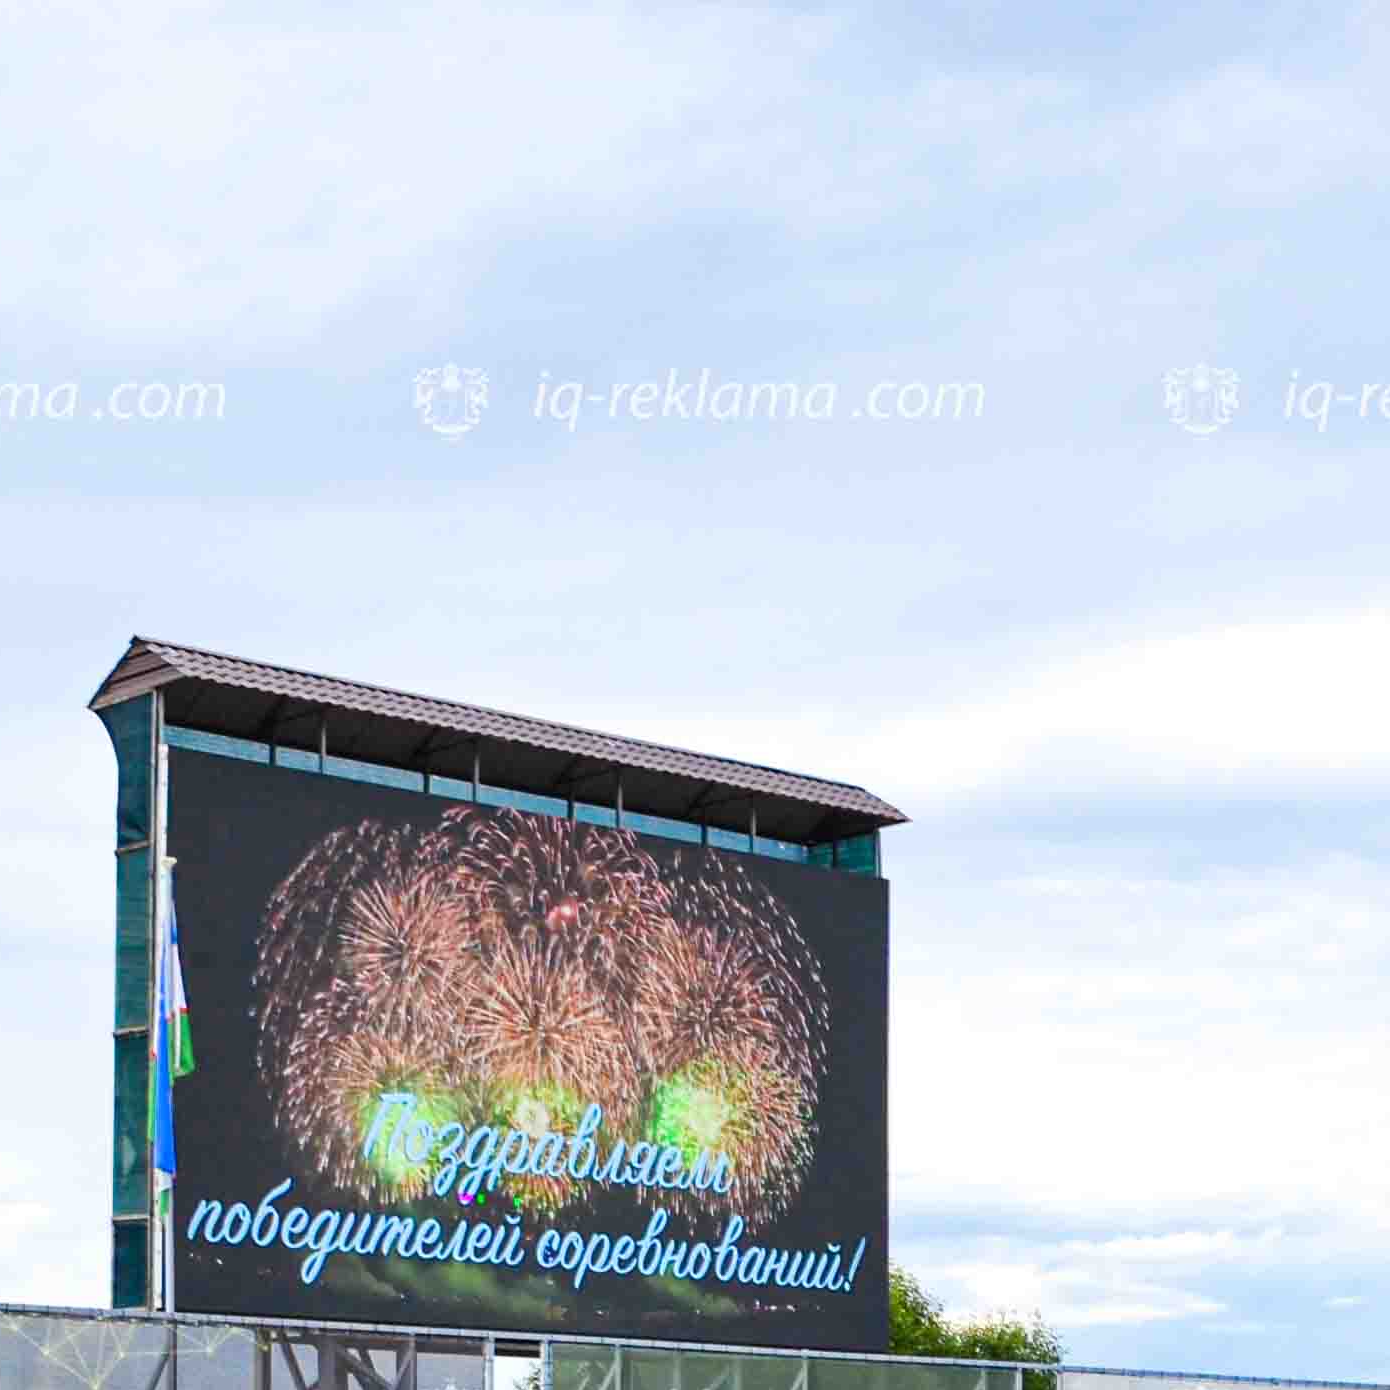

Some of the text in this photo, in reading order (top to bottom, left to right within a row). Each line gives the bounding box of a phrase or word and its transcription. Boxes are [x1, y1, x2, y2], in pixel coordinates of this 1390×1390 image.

[362, 1091, 735, 1204] Поздравляем
[187, 1177, 867, 1295] победителей соревнований!
